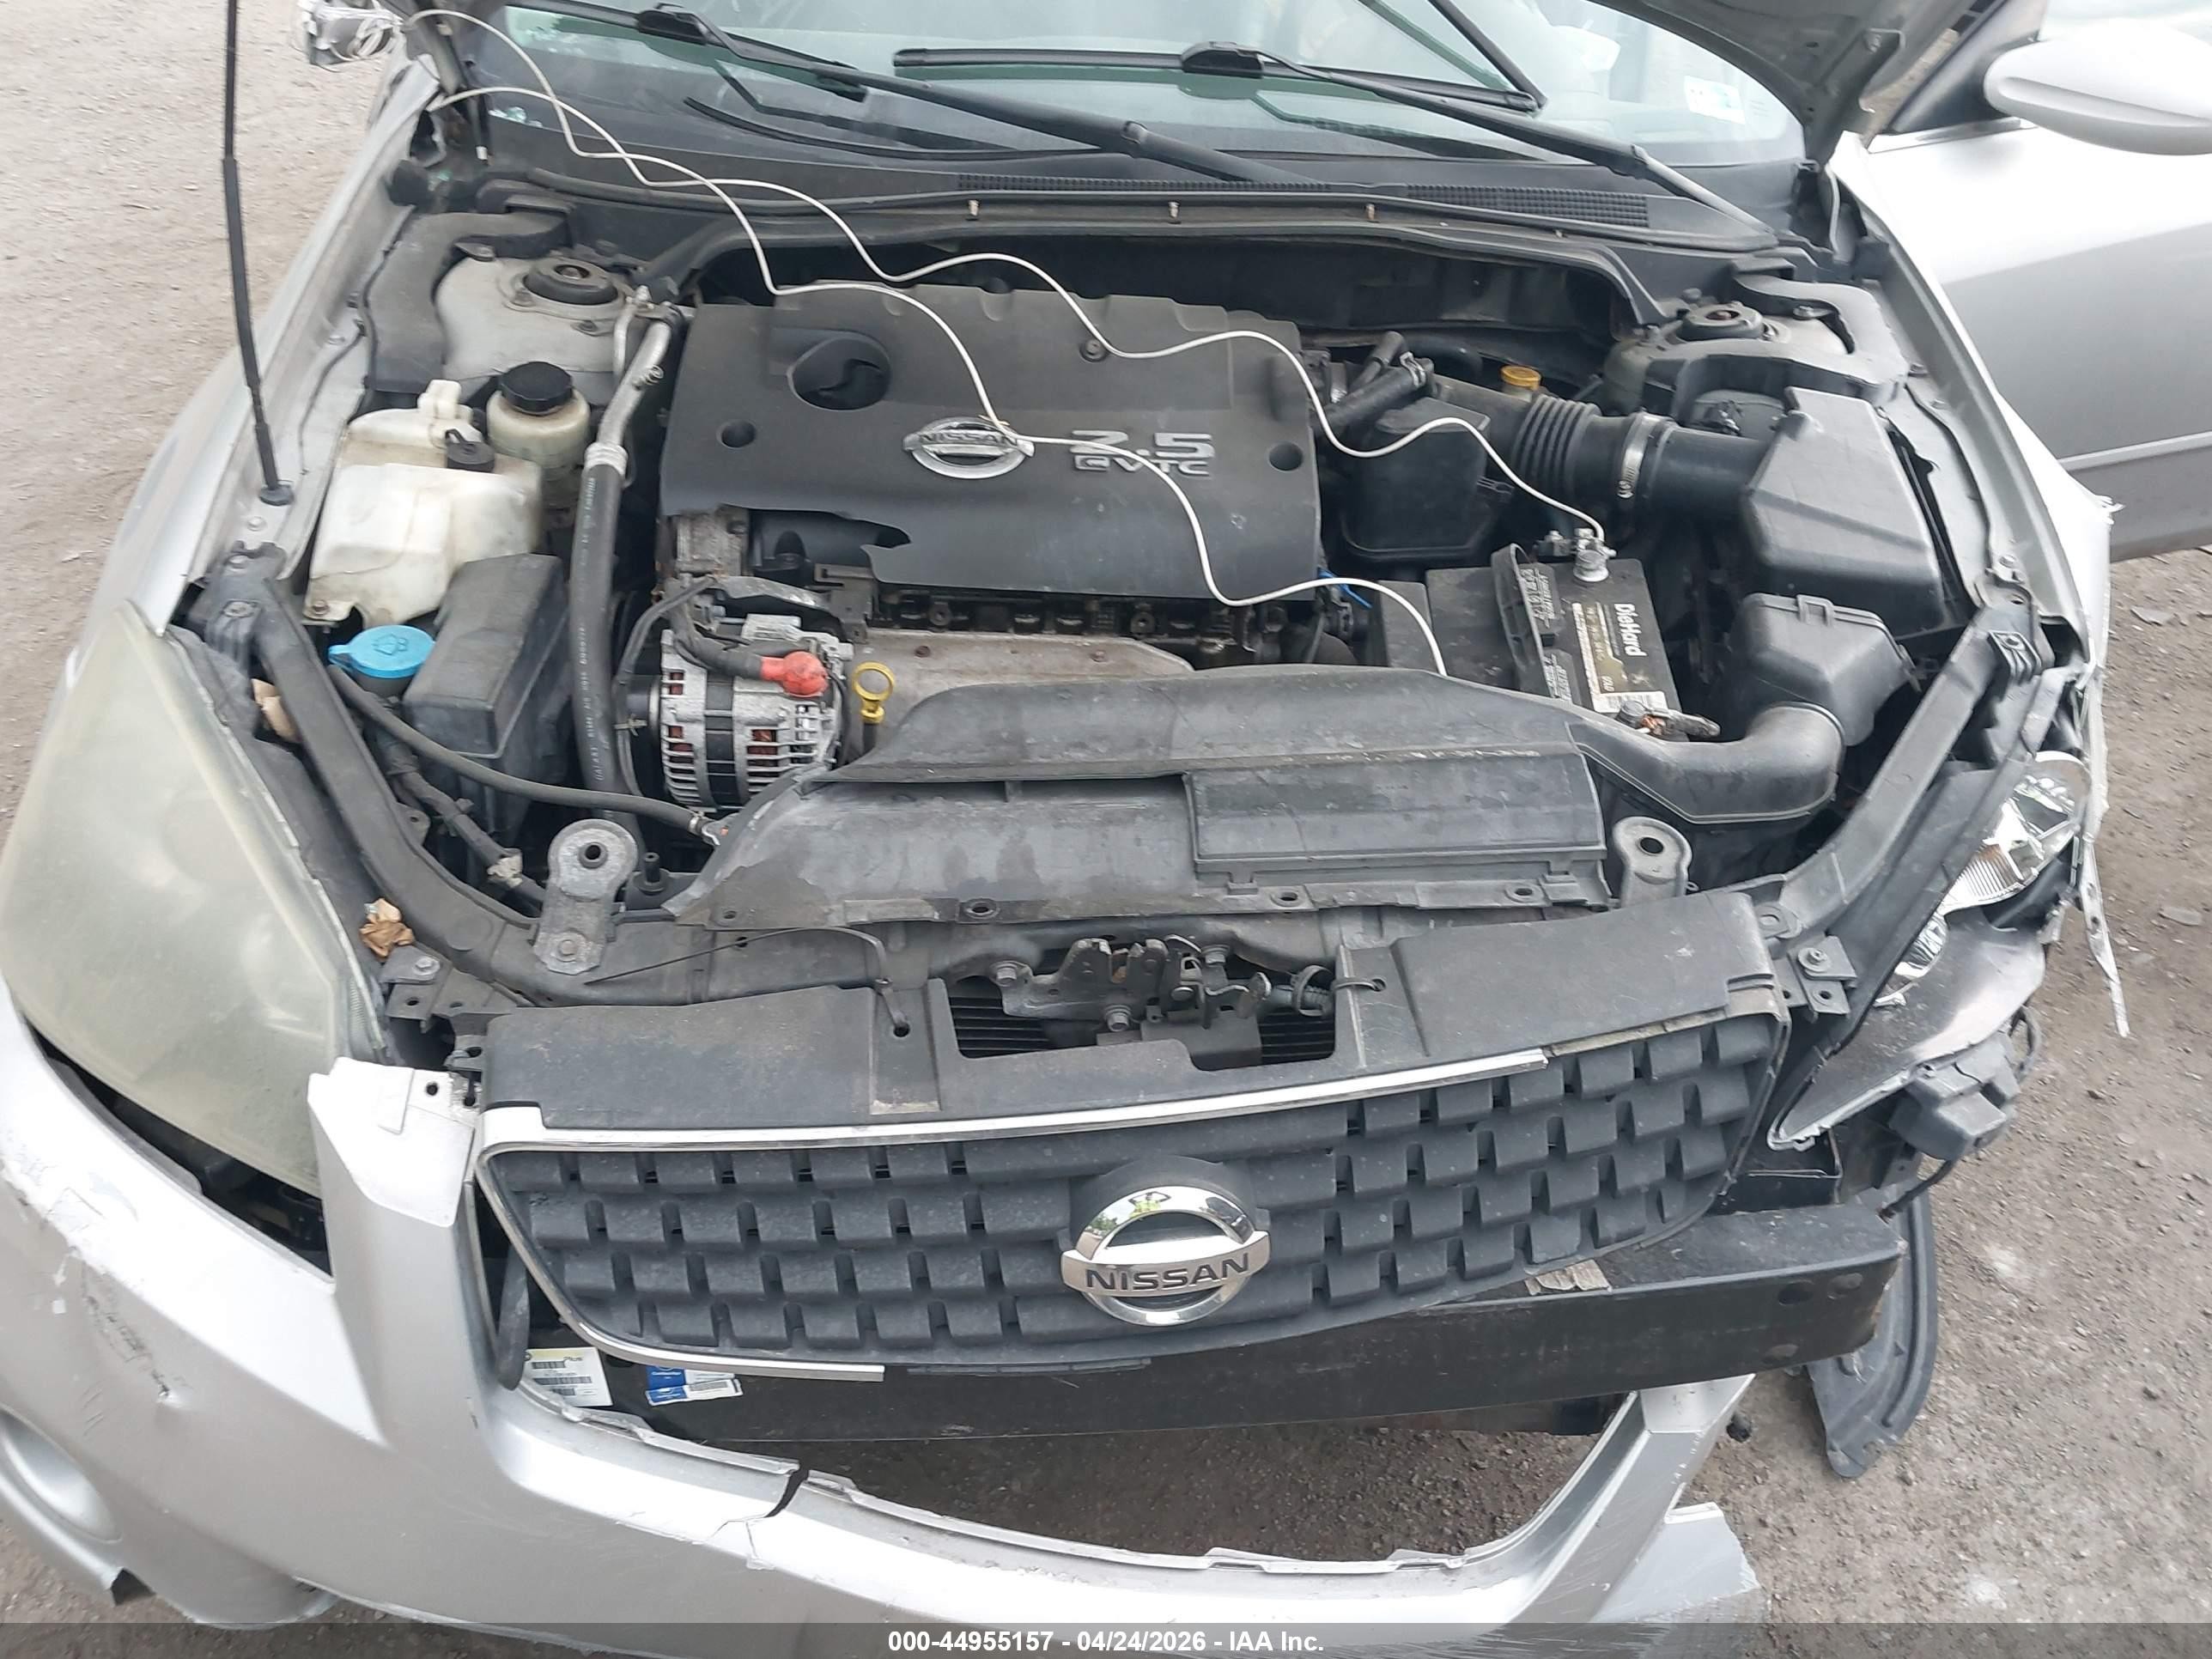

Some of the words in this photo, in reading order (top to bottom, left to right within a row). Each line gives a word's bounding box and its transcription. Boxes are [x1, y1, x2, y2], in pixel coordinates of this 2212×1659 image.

[919, 432, 1018, 447] NISSAN
[1070, 430, 1216, 458] 2.5
[1613, 603, 1648, 656] DieHard
[1085, 1252, 1249, 1291] NISSAN
